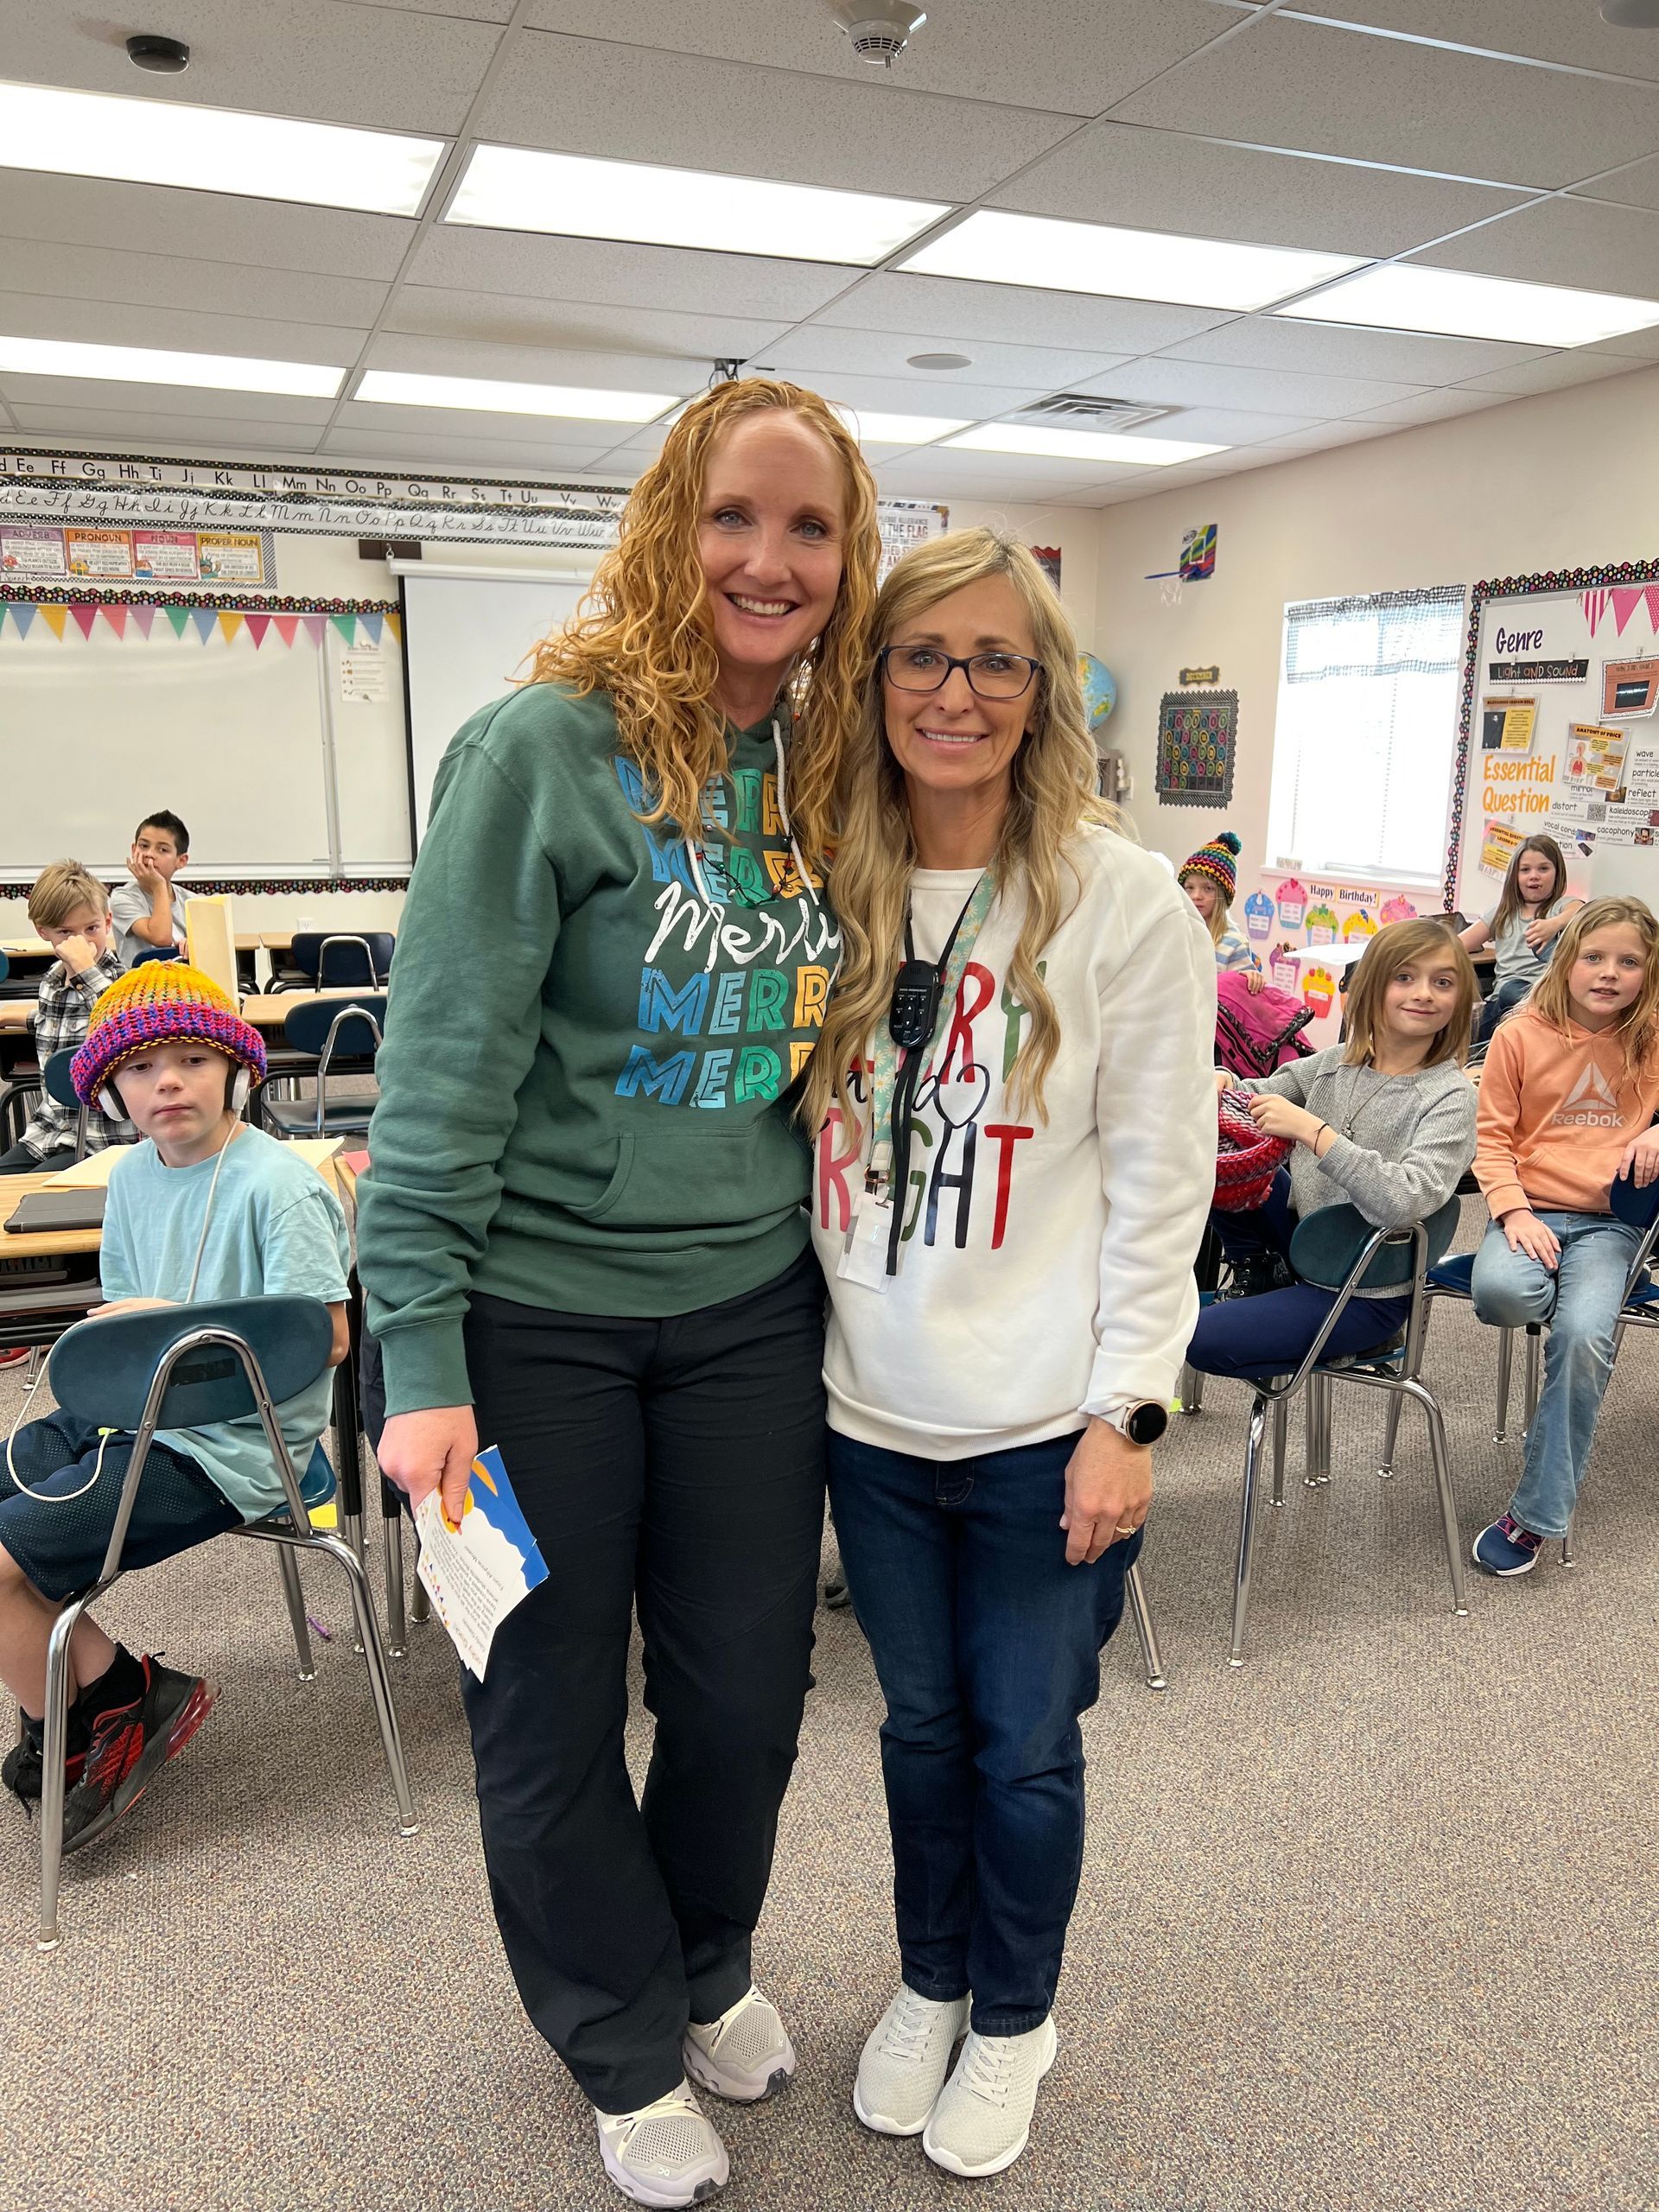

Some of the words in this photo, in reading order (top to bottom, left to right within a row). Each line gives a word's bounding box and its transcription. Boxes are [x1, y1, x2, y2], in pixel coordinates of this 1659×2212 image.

[16, 458, 34, 473] Ee
[51, 460, 66, 474] Ff
[82, 462, 105, 480] Gg
[119, 464, 139, 479] Hh
[181, 468, 194, 486] Jj
[215, 471, 233, 486] Kk
[283, 476, 307, 490] Mm
[316, 478, 336, 492] Nn
[346, 480, 366, 494] Oo
[377, 482, 392, 498] Pp
[408, 483, 429, 500] Qq
[442, 486, 456, 499] Rr
[471, 487, 486, 500] Ss
[499, 489, 512, 502] Tt
[521, 490, 537, 503] Uu
[561, 493, 577, 505] Vv
[13, 530, 50, 539] ADVERB
[74, 532, 122, 542] PRONOUN
[907, 524, 928, 538] FLAG
[201, 537, 232, 546] PROPER
[1496, 627, 1543, 654] Genre
[1484, 754, 1555, 783] Essential
[1632, 768, 1659, 779] particle
[1483, 786, 1550, 813] Question
[1628, 788, 1656, 798] reflect
[1552, 802, 1577, 811] distort
[1544, 821, 1560, 830] vocal
[1597, 826, 1634, 836] cacophony
[641, 823, 824, 907] MERR
[1310, 884, 1333, 899] Happy
[1339, 889, 1376, 904] Birthday!
[638, 965, 830, 1036] MERR
[1553, 1111, 1624, 1128] Reebok
